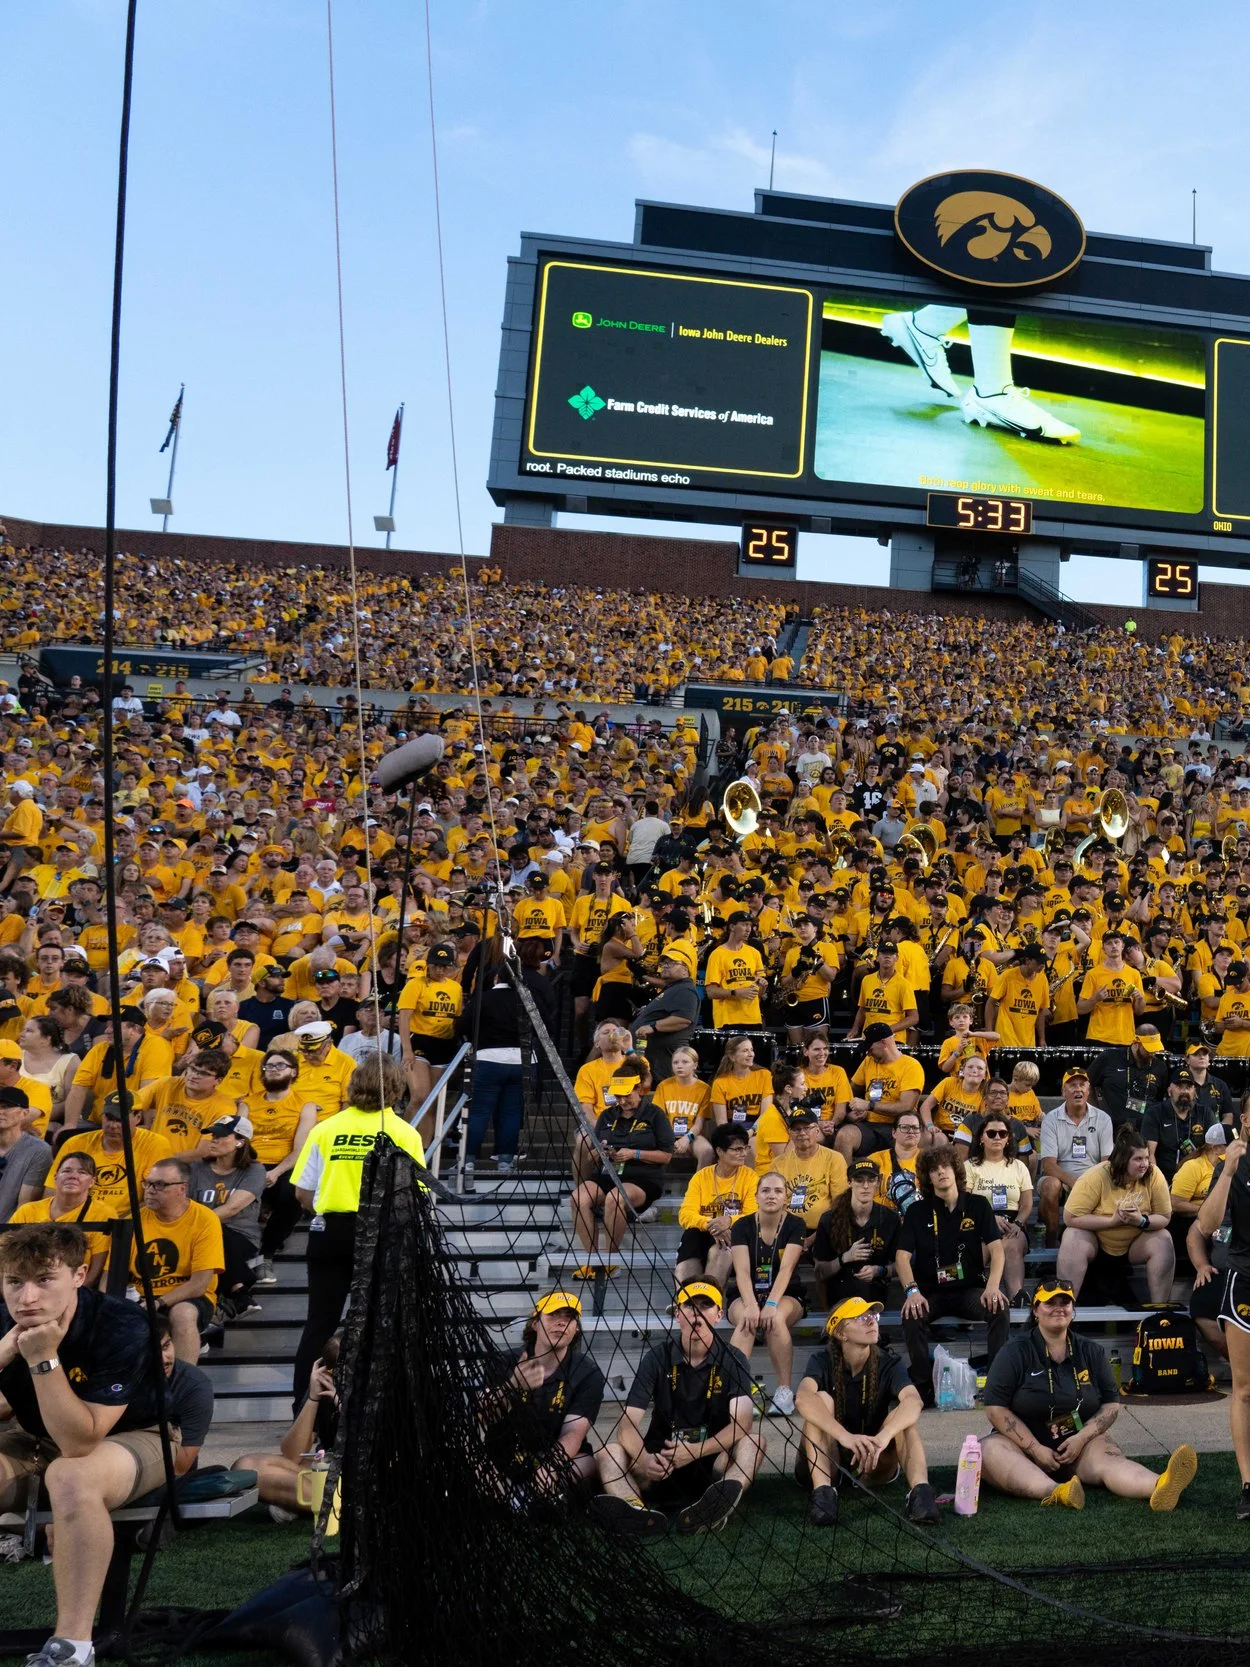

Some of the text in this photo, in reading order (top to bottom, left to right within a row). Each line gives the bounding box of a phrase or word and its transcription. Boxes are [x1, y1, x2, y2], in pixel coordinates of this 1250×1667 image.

[596, 317, 666, 333] JOHN DEERE
[679, 325, 788, 347] Iowa John Deere Dealers
[607, 398, 774, 426] Farm Credit Services of America
[526, 462, 690, 485] root. Packed stadiums echo
[971, 480, 997, 494] glory
[999, 483, 1021, 495] with
[1023, 487, 1054, 498] sweat
[1056, 488, 1074, 499] and
[1077, 491, 1105, 502] tears.
[957, 497, 1025, 531] 5:33
[1213, 521, 1232, 531] OHIO
[748, 528, 789, 560] 25
[1155, 563, 1192, 593] 25
[96, 659, 132, 675] 214
[722, 697, 753, 712] 215
[862, 791, 883, 810] 16
[526, 917, 547, 926] IOWA
[728, 968, 752, 977] IOWA
[429, 1001, 456, 1013] IOWA
[866, 1000, 888, 1009] IOWA
[1013, 999, 1036, 1009] IOWA
[1226, 1009, 1249, 1018] IOWA
[727, 1093, 762, 1107] IOWA
[665, 1100, 699, 1115] IOWA
[734, 1112, 746, 1121] GUEST
[674, 1125, 687, 1133] GUEST
[791, 1195, 804, 1203] GUEST
[147, 1242, 159, 1254] A
[153, 1256, 166, 1266] N
[160, 1266, 171, 1275] F
[1149, 1337, 1184, 1350] IOWA
[1157, 1368, 1178, 1377] BAND
